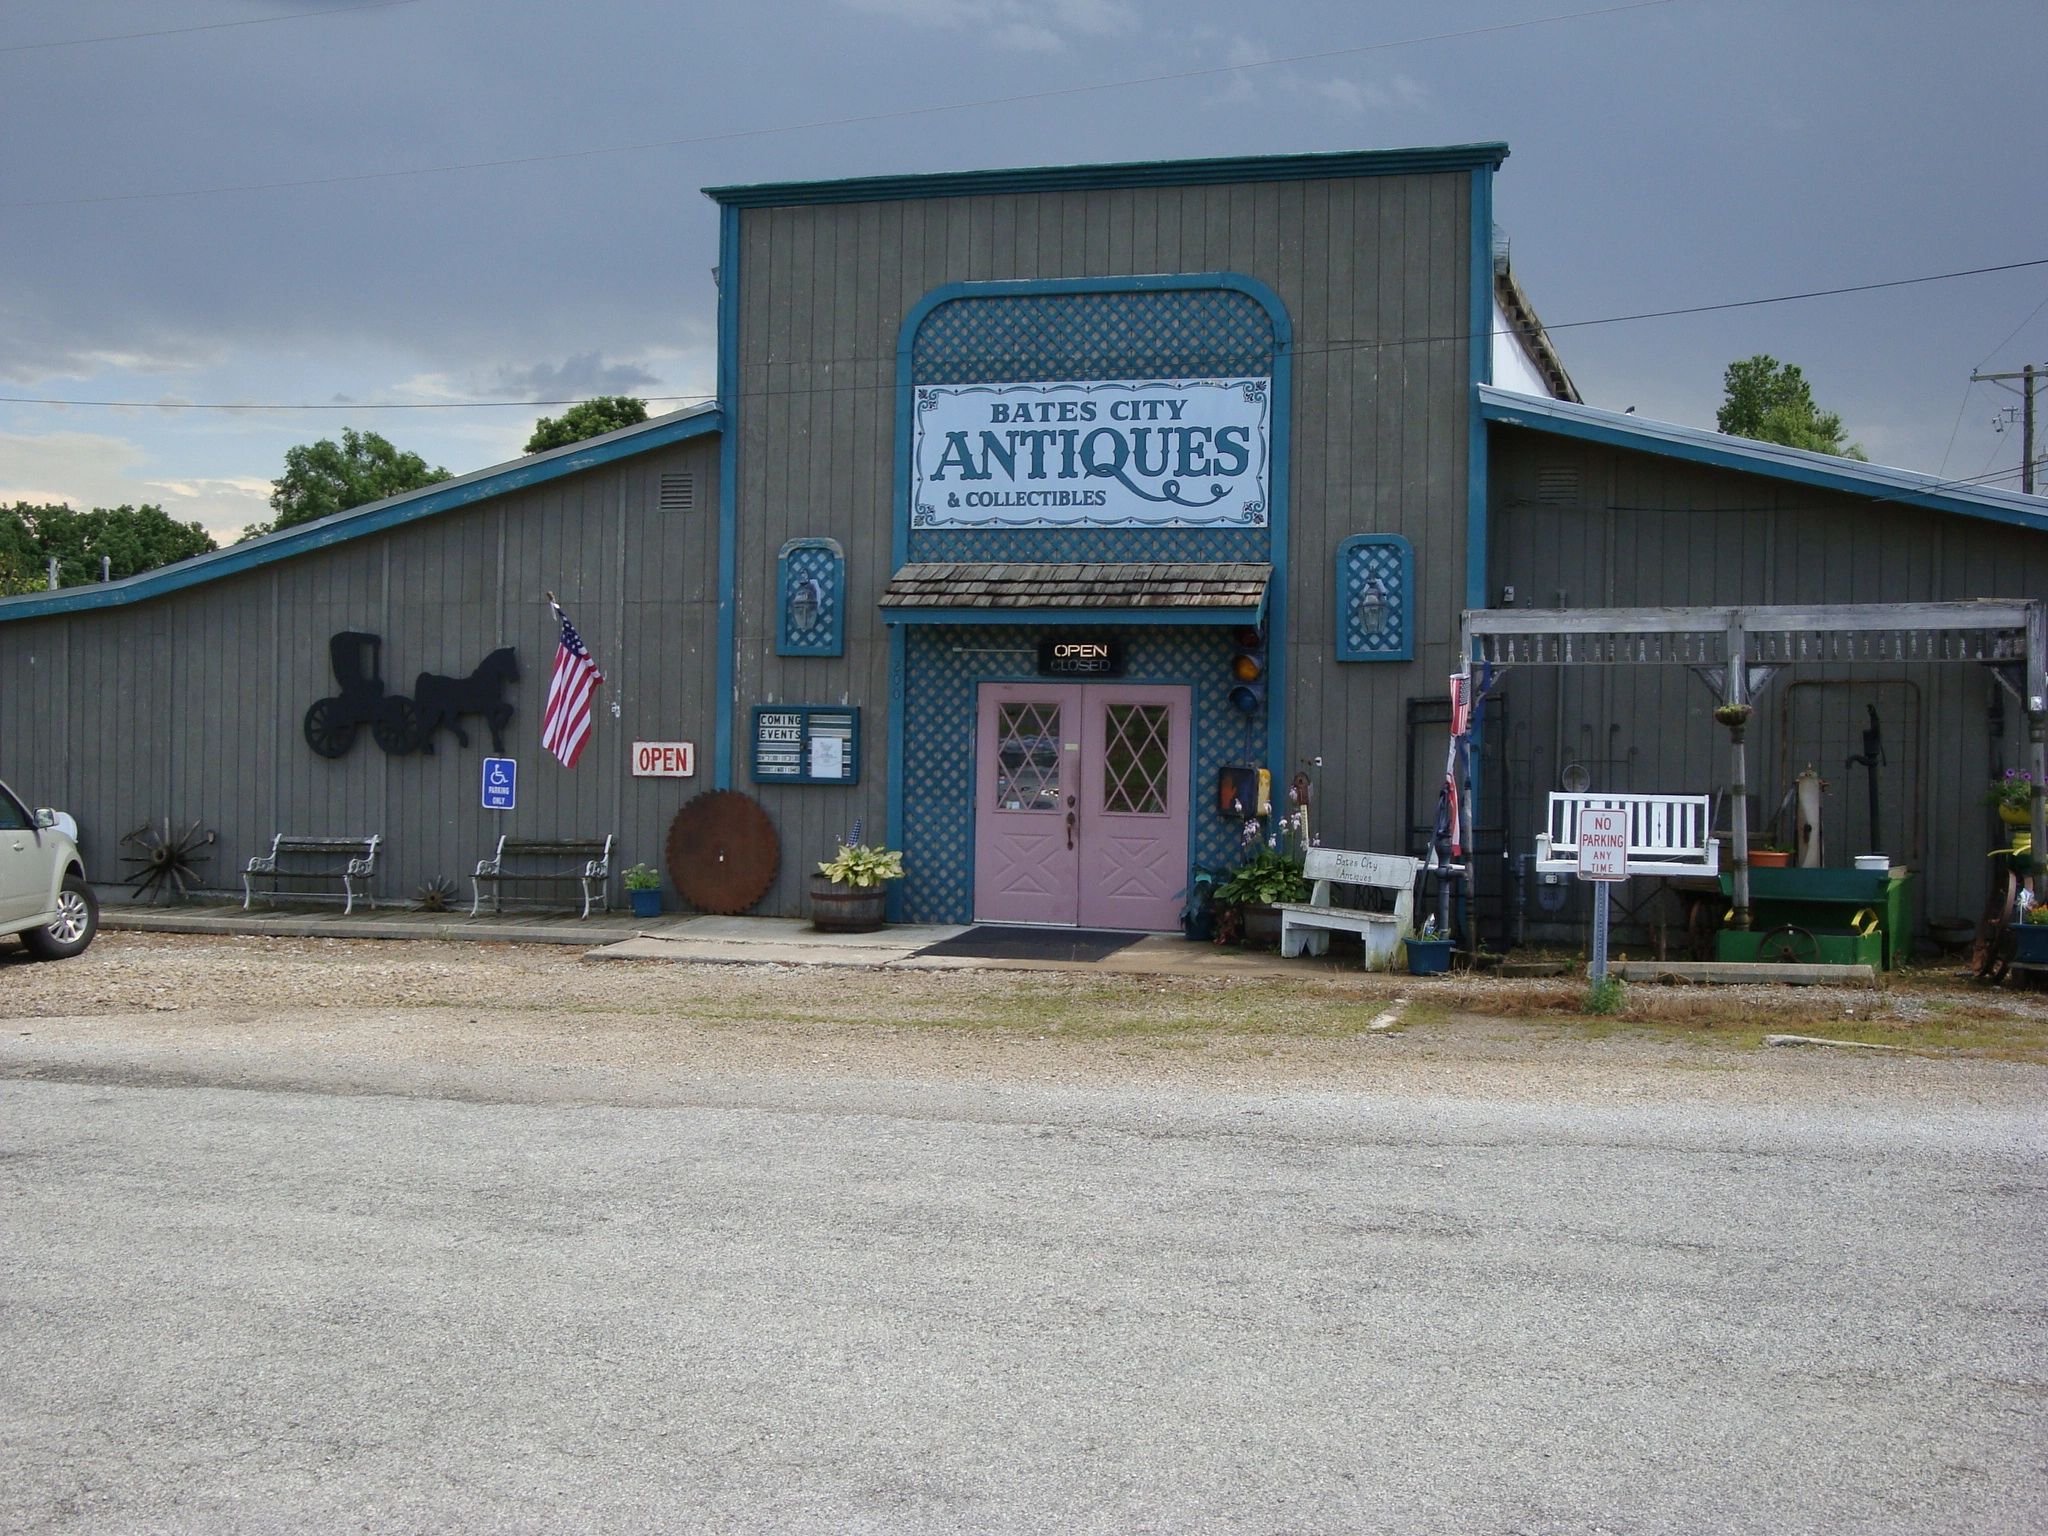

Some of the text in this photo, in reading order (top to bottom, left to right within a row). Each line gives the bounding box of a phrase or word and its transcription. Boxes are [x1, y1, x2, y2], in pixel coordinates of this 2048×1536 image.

[990, 399, 1189, 424] BATES CITY
[930, 425, 1250, 507] ANTIQUES
[947, 490, 1107, 508] & COLLECTIBLES
[1054, 644, 1107, 657] OPEN
[1050, 660, 1111, 671] CLOSED
[760, 715, 801, 725] COMING
[760, 729, 801, 739] EVENTS
[639, 747, 687, 772] OPEN
[488, 786, 510, 795] PARKING
[492, 796, 505, 805] ONLY
[1594, 817, 1612, 831] NO
[1582, 834, 1624, 848] PARKING
[1593, 851, 1612, 860] ANY
[1336, 854, 1378, 871] Bates City
[1591, 864, 1613, 873] TIME
[1340, 869, 1372, 882] Antiques
